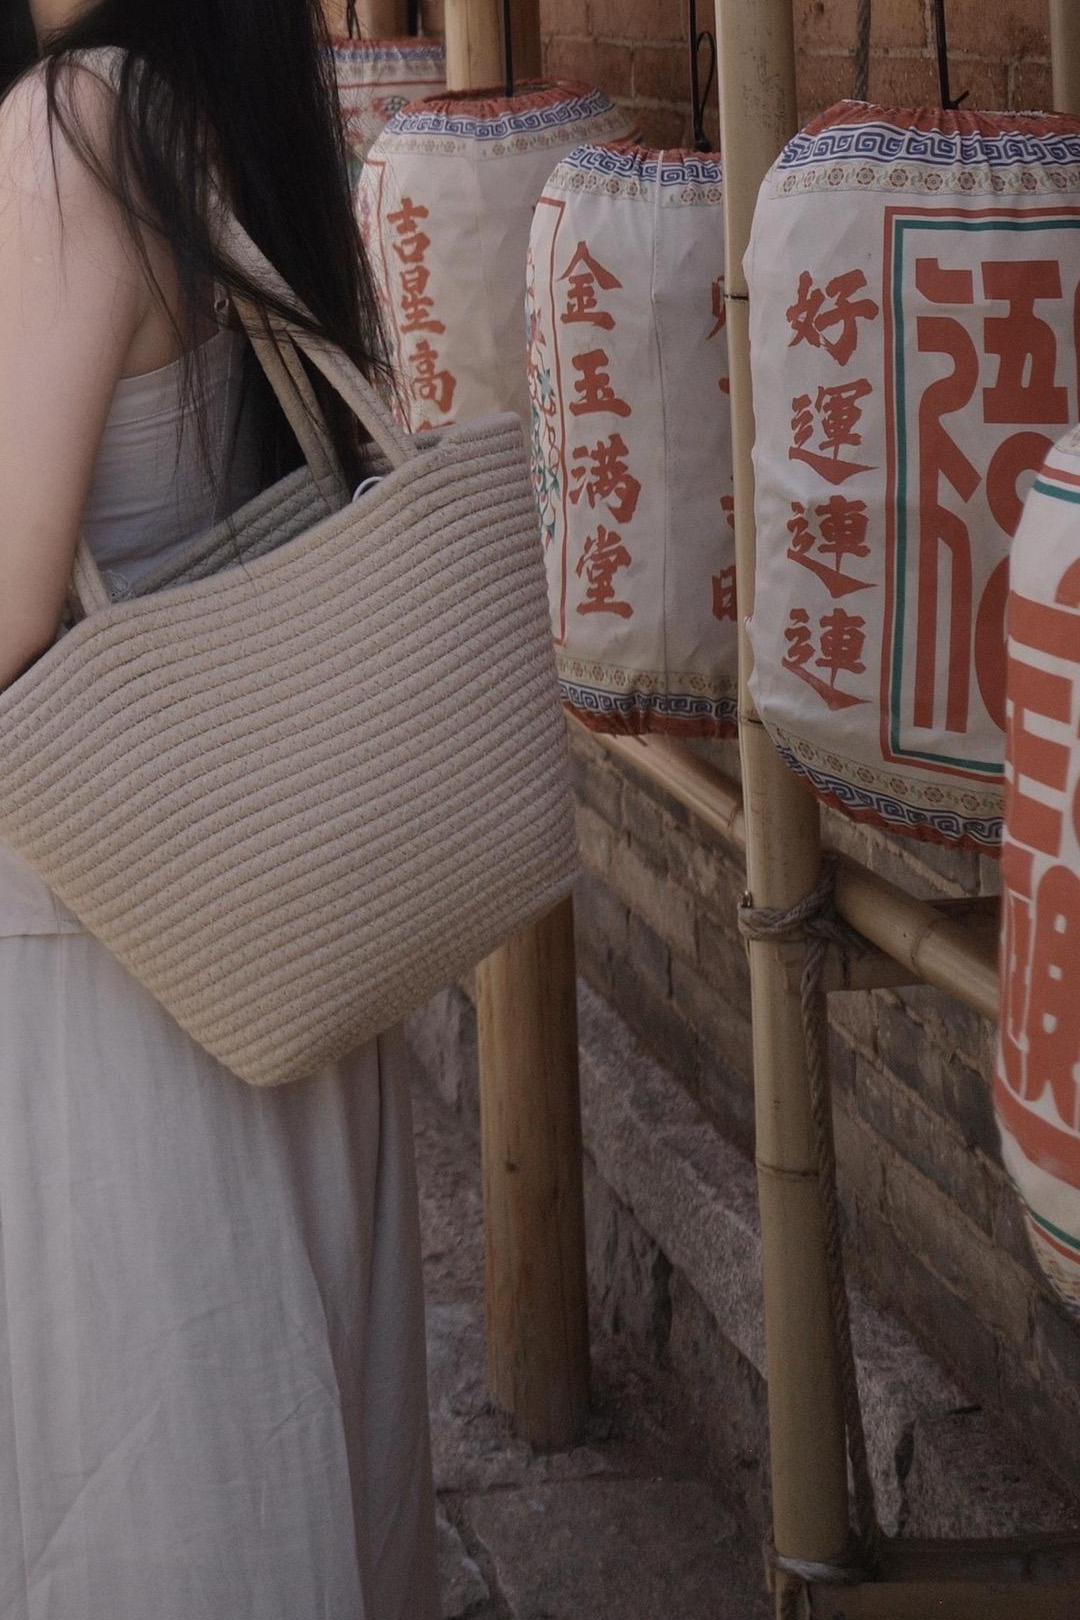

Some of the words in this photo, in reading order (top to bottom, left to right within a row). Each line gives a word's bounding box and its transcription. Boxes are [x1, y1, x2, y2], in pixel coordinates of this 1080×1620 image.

[386, 196, 458, 432] 吉星高
[782, 269, 879, 711] 好運連連
